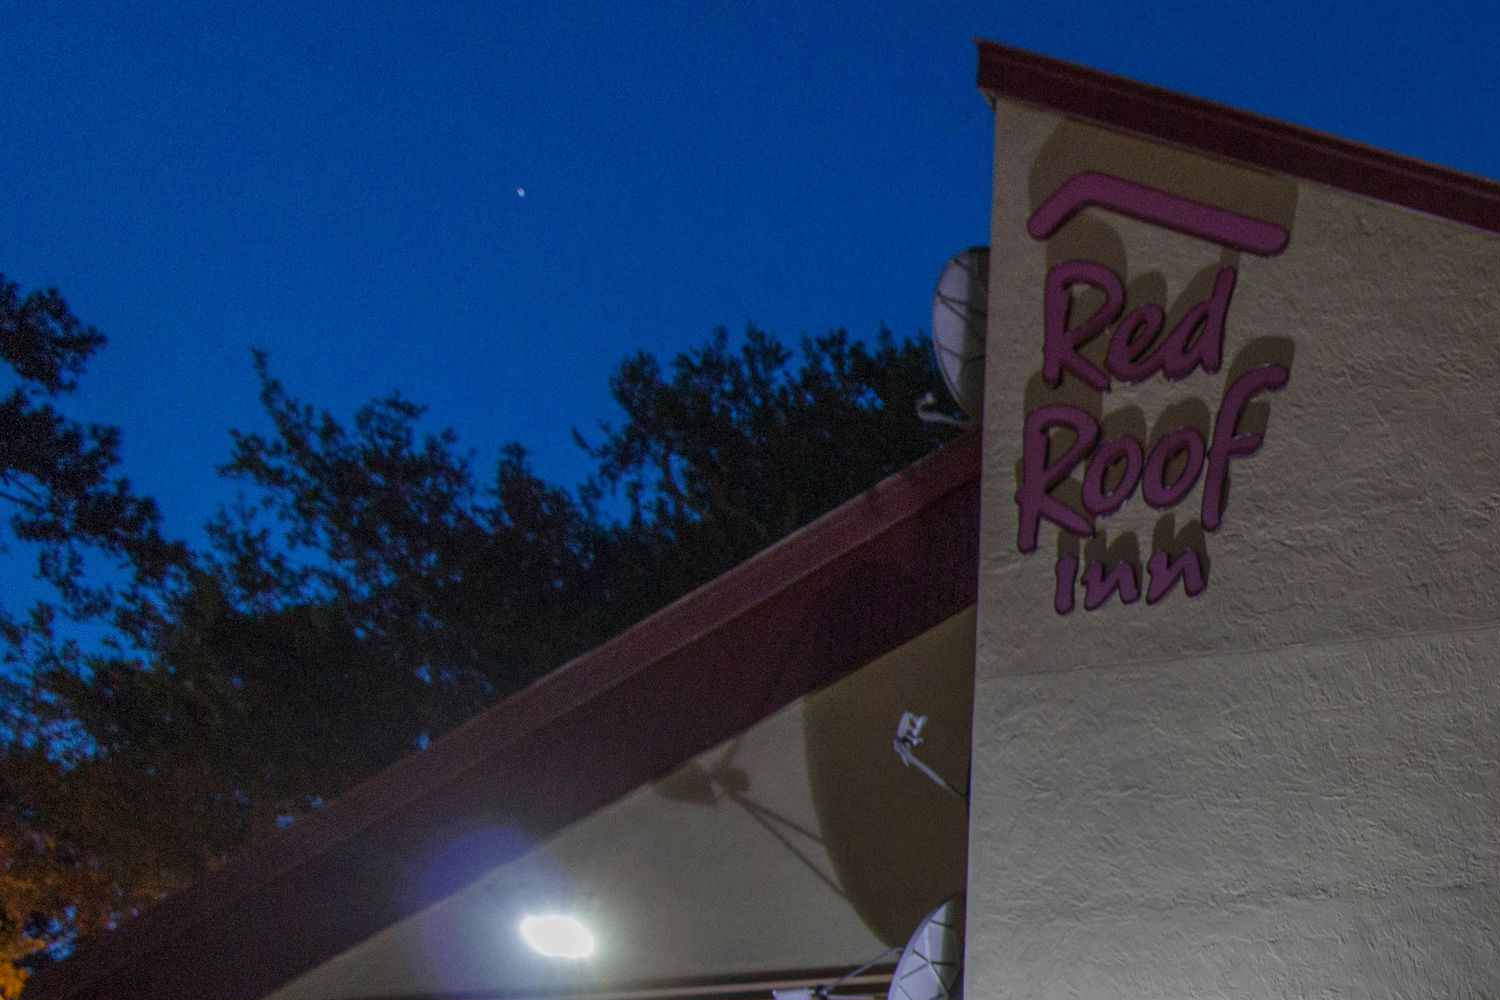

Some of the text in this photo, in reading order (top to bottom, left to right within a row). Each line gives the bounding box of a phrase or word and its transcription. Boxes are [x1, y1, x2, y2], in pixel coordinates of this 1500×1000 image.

[1044, 260, 1236, 390] Red
[1017, 364, 1289, 553] Roof
[1055, 551, 1206, 615] Inn
